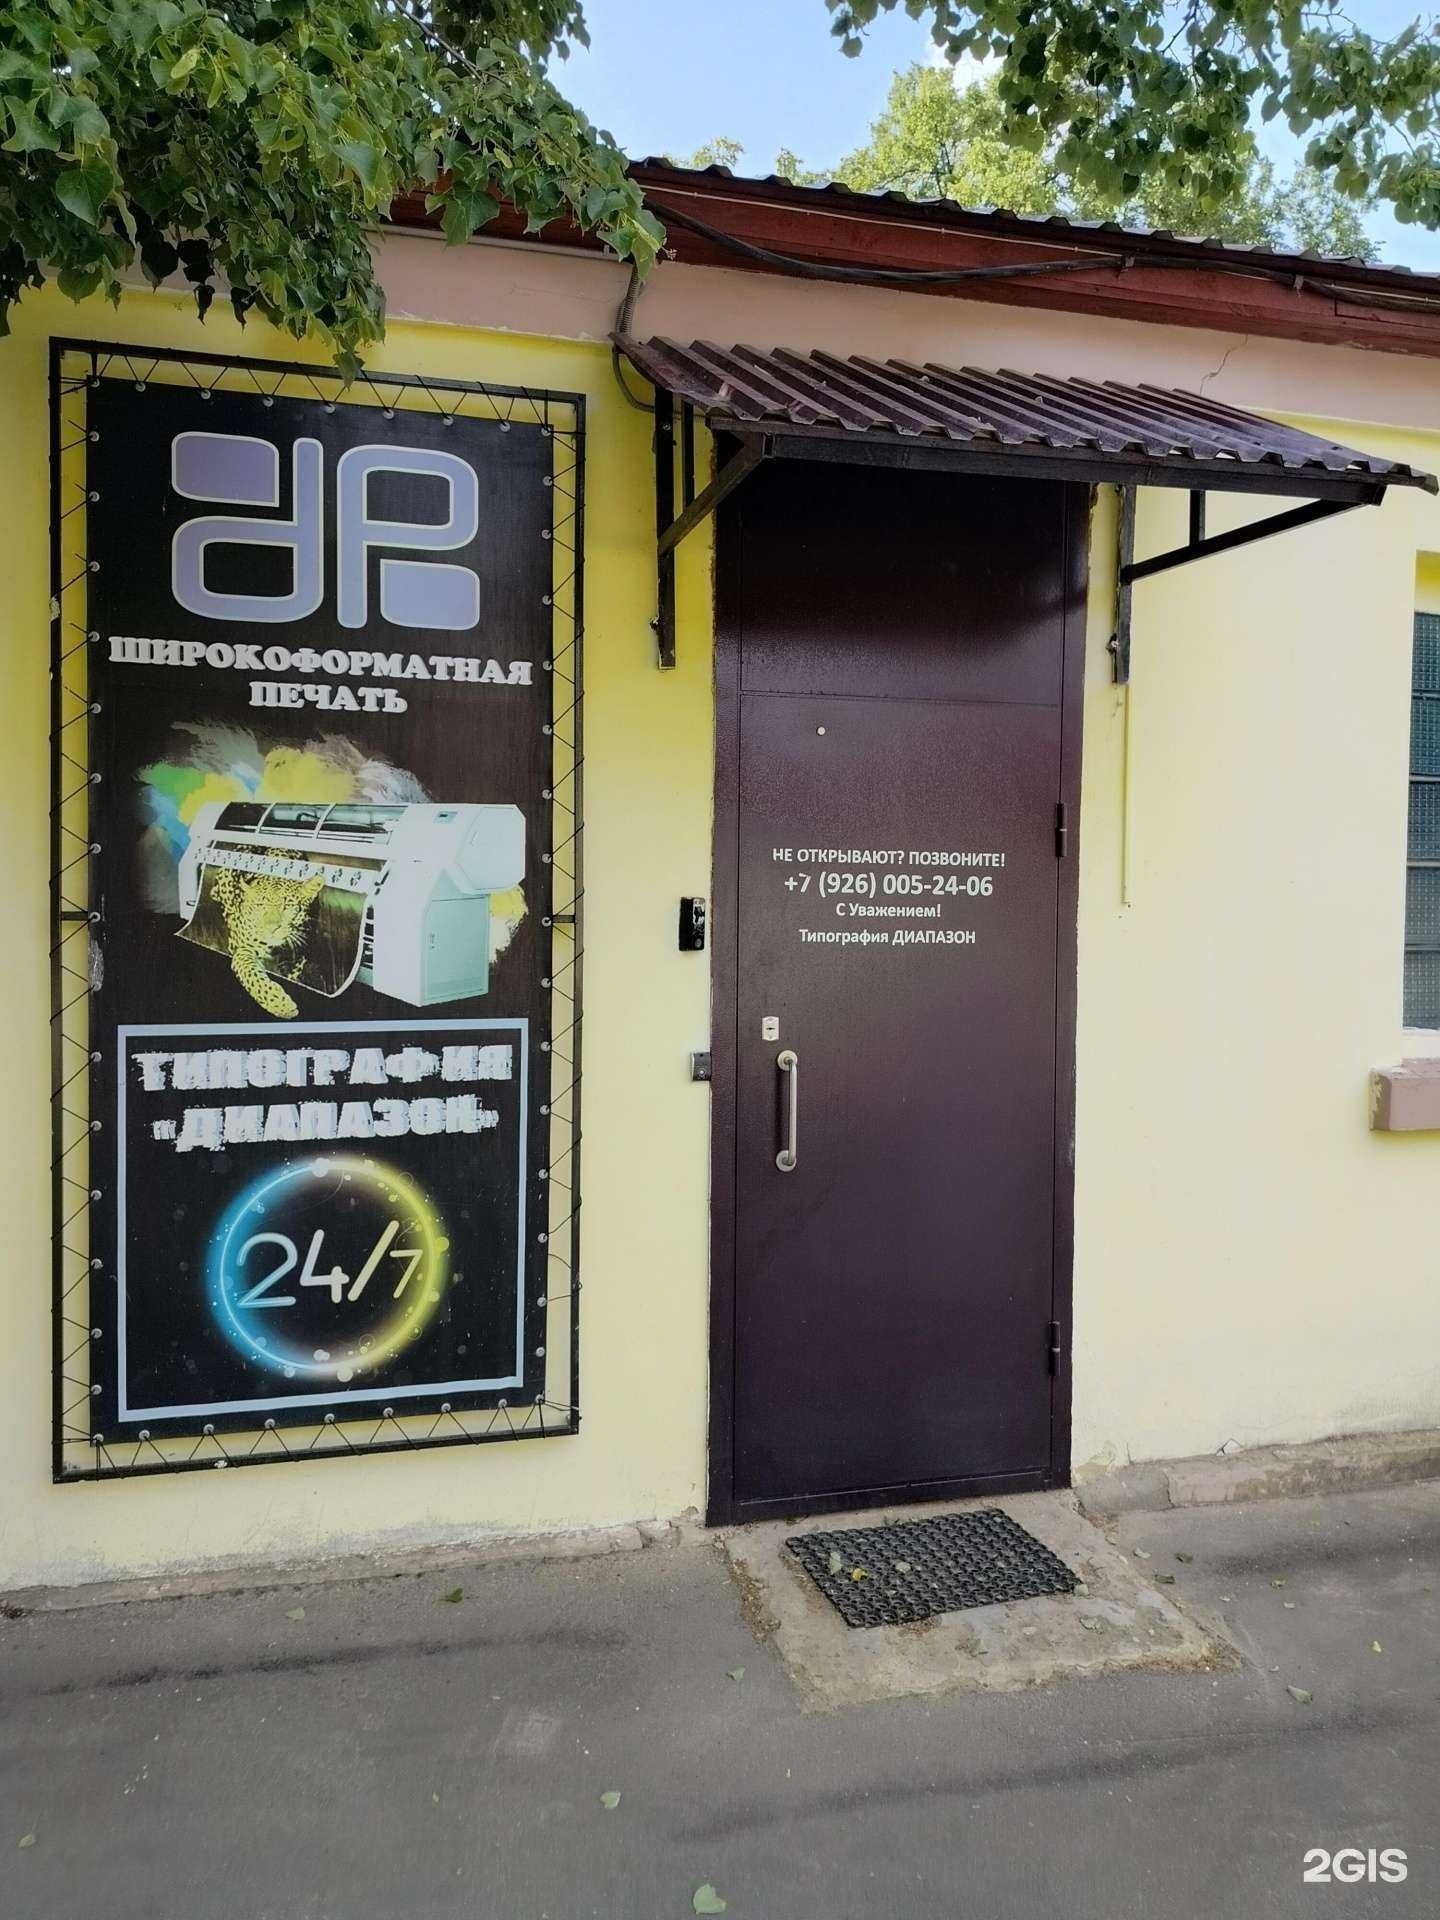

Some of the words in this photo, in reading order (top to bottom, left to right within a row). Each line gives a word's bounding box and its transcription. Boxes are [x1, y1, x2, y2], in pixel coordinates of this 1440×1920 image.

[108, 635, 533, 685] ШИРОКОФОРМАТНАЯ
[248, 681, 408, 714] ПЕЧАТЬ
[772, 848, 793, 862] НЕ
[797, 849, 905, 866] ОТКРЫВАЮТ?
[909, 851, 1006, 867] ПОЗВОНИТЕ!
[784, 873, 812, 894] +7
[819, 871, 877, 898] (926)
[883, 874, 994, 896] 005-24-06
[849, 902, 942, 918] Уважением!
[799, 929, 889, 946] Типография
[892, 930, 976, 946] ДИАПАЗОН
[131, 1043, 513, 1091] ТИПОГРАФИЯ
[237, 1220, 424, 1309] 24/7
